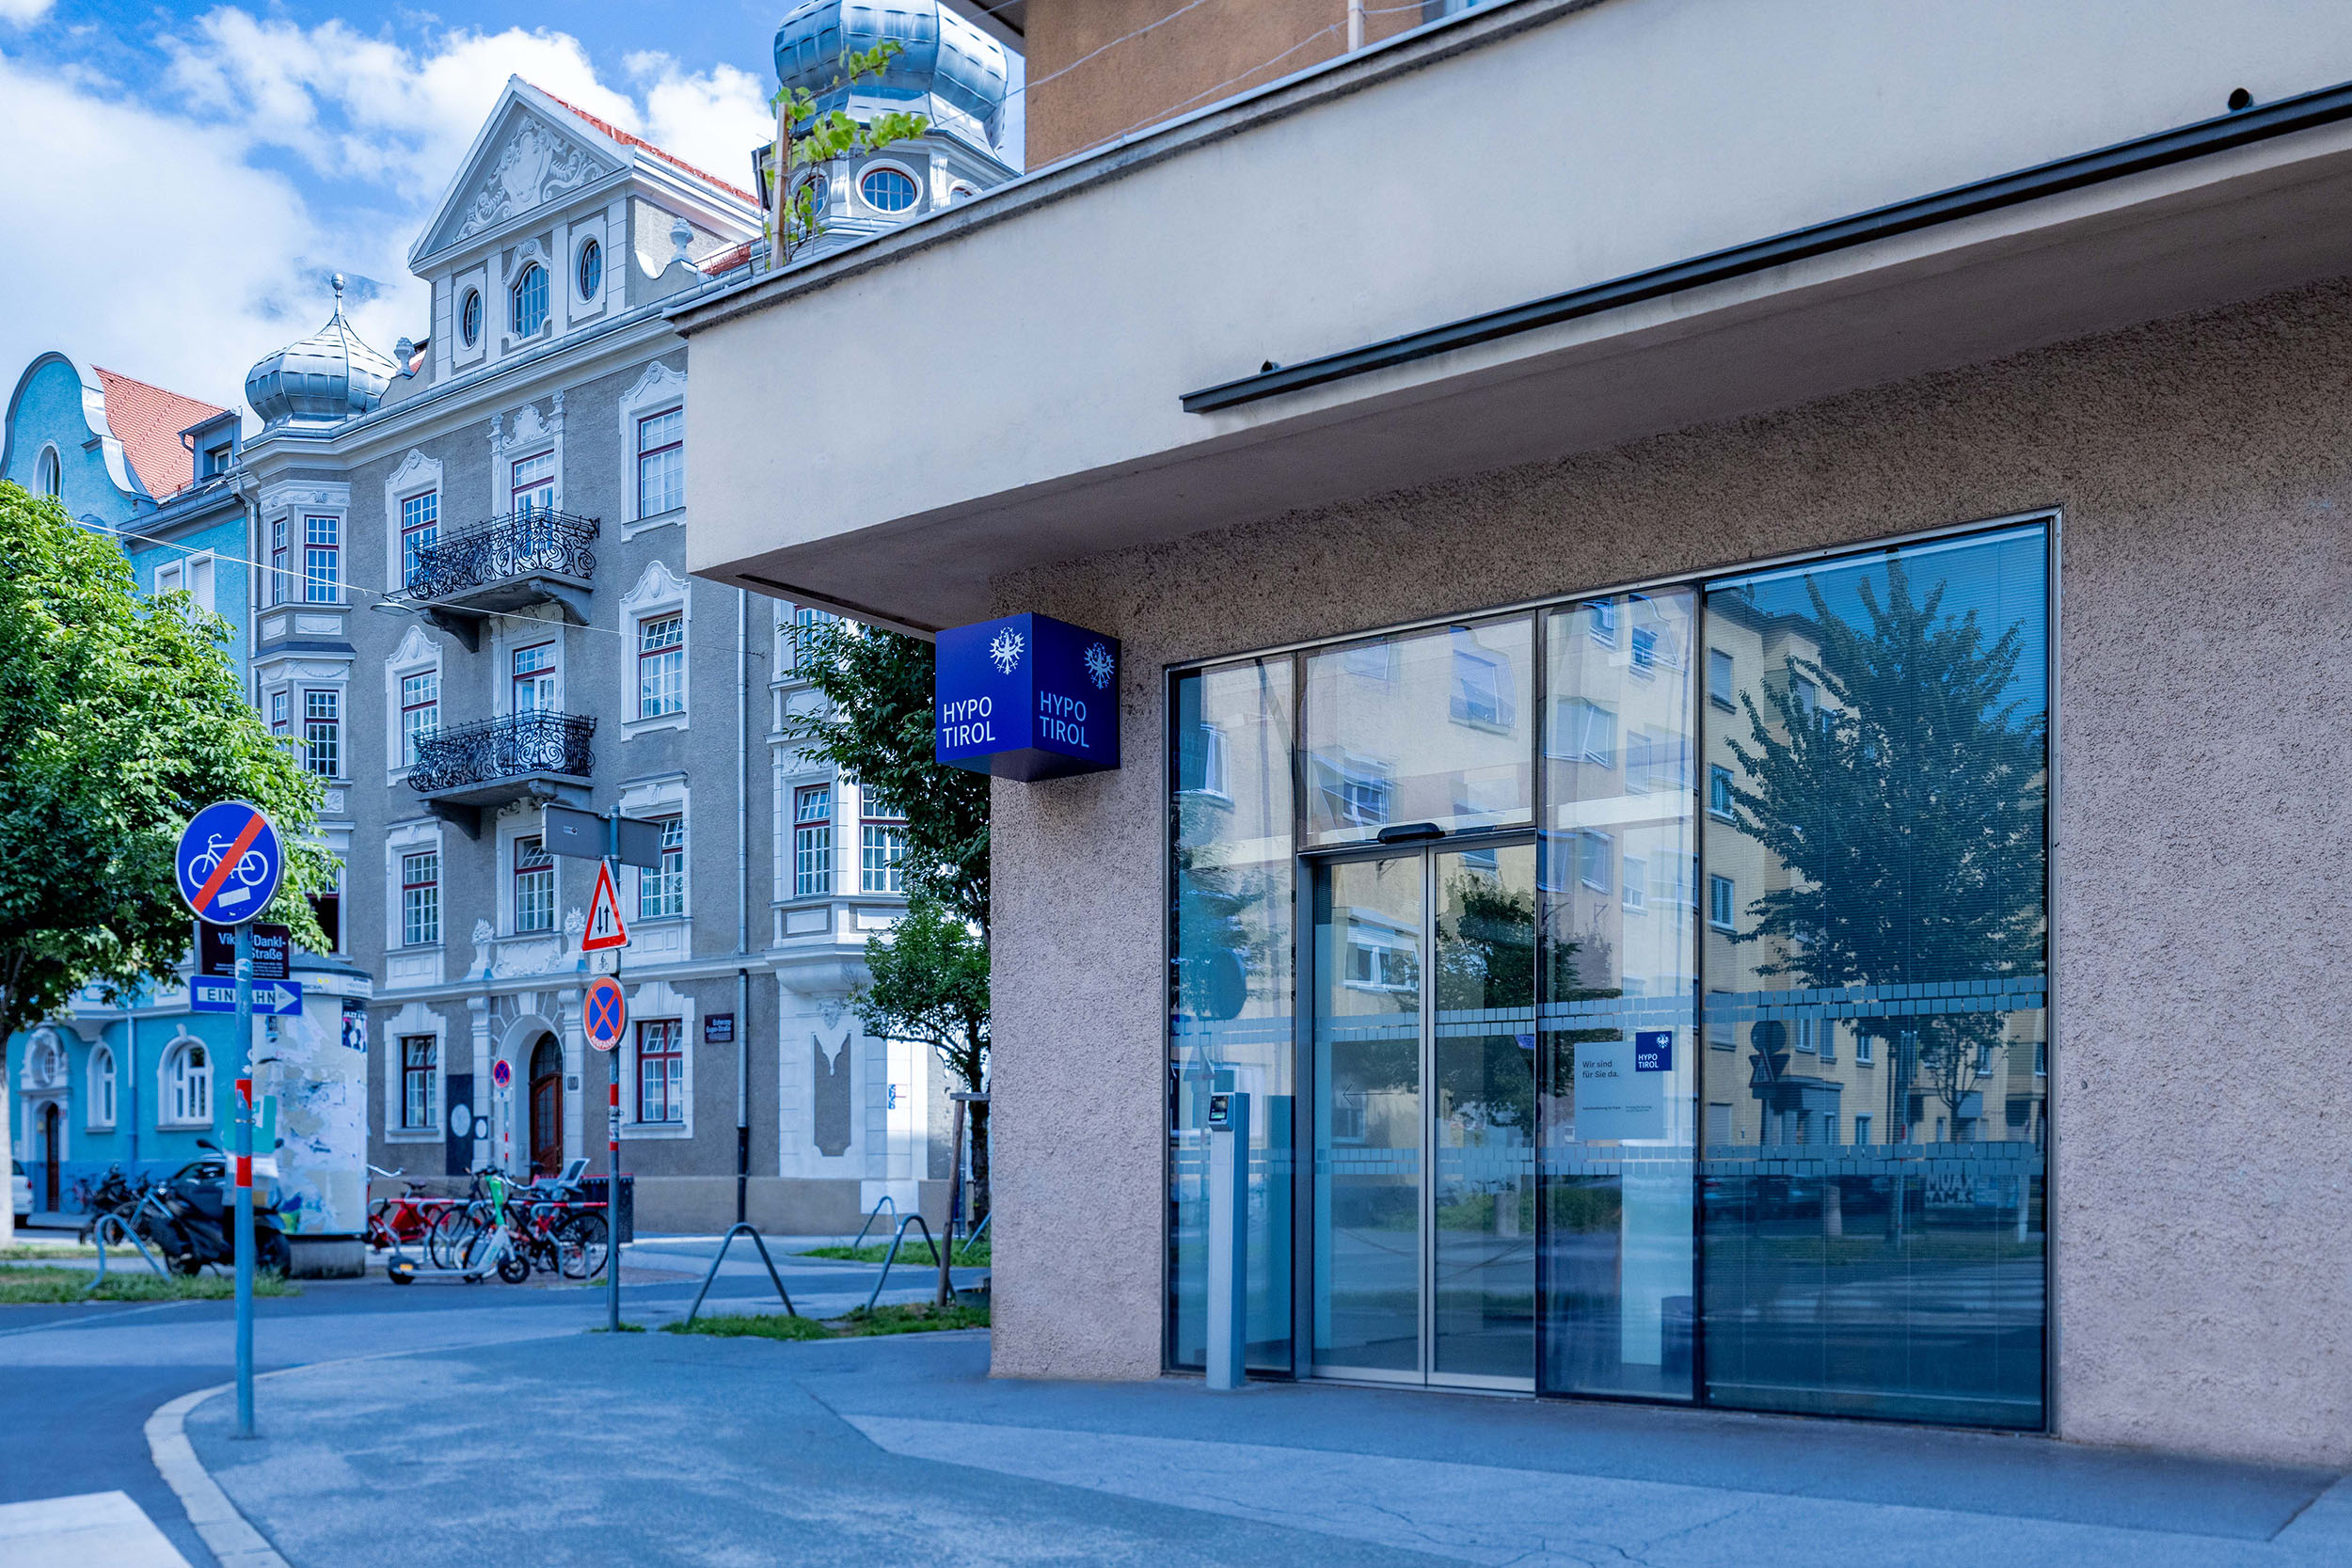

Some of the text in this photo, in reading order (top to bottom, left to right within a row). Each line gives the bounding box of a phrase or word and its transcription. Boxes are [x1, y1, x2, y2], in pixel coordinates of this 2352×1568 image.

[944, 696, 993, 724] HYPO
[1041, 690, 1087, 721] HYPO
[943, 721, 995, 748] TIROL
[1040, 715, 1089, 748] TIROL
[208, 989, 275, 1004] EINHN
[1608, 1069, 1619, 1078] da.
